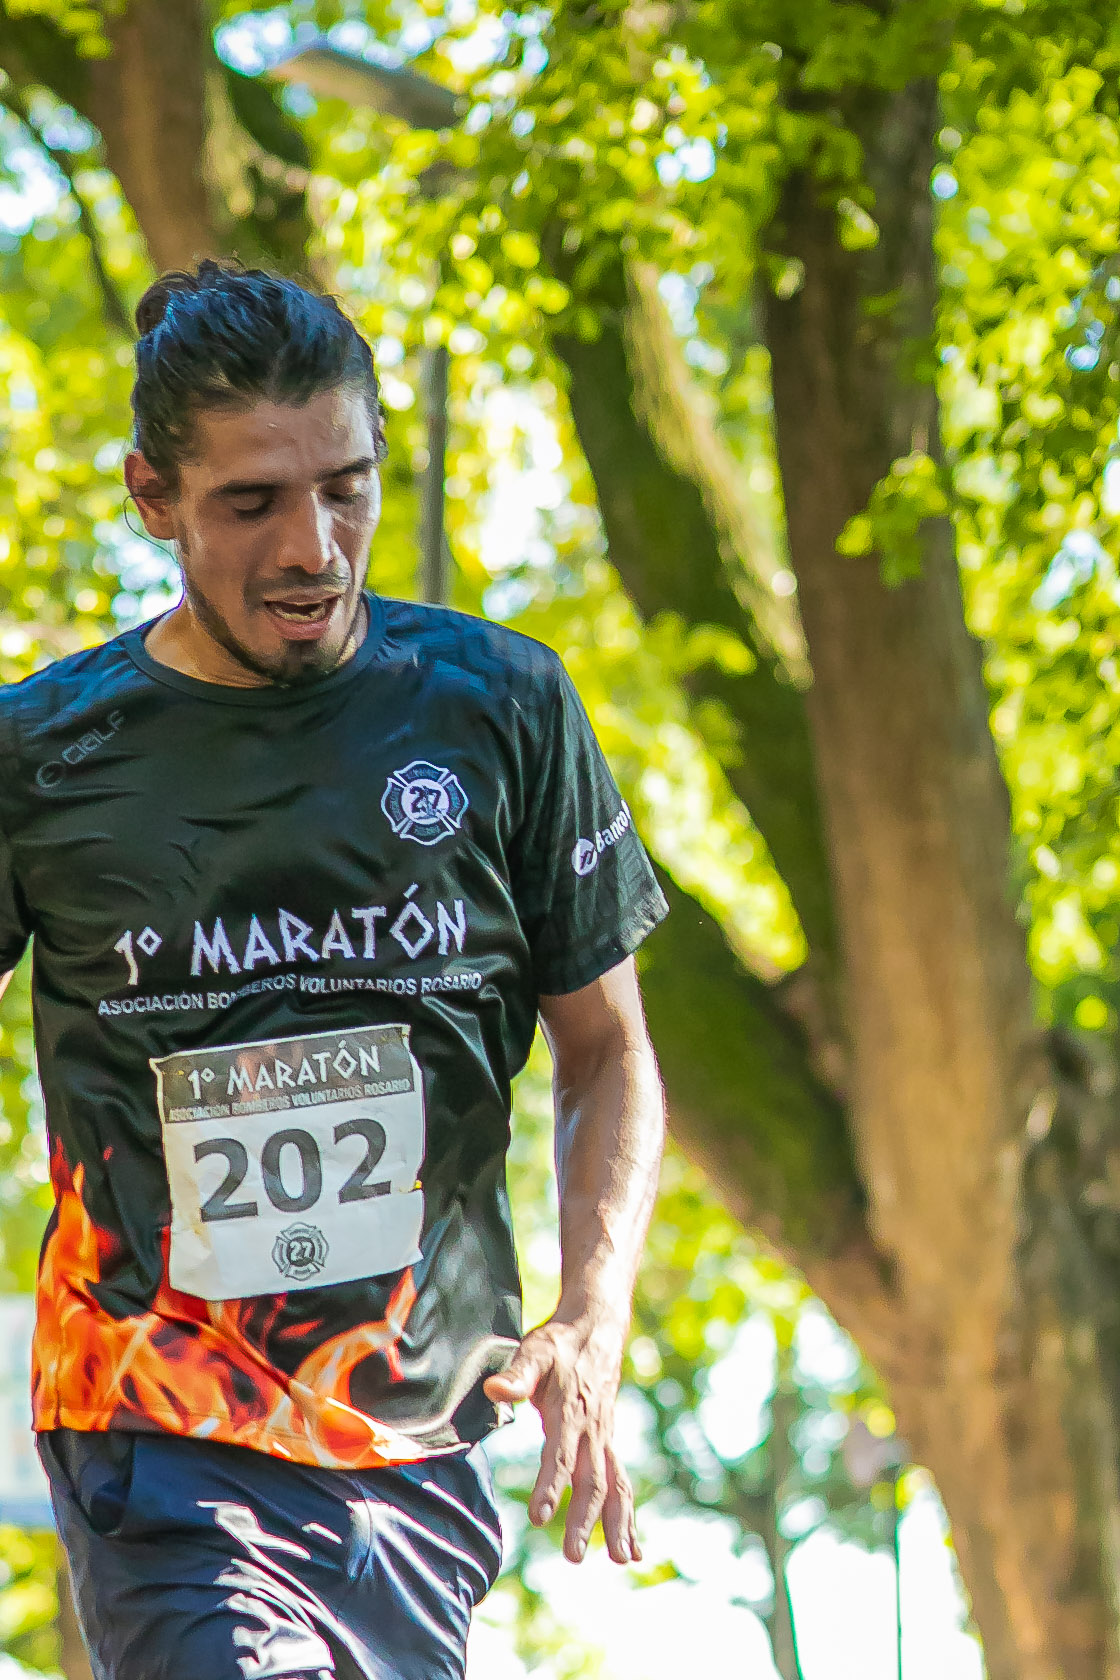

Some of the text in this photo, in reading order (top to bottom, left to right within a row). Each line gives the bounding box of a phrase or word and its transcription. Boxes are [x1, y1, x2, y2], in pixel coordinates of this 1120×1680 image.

[408, 784, 442, 814] 27
[190, 882, 468, 977] MARATÓN
[299, 974, 418, 996] VOLUNTARIOS
[421, 972, 482, 994] ROSARIO
[226, 1040, 382, 1095] MARATÓN
[193, 1118, 391, 1222] 202
[290, 1240, 313, 1262] 27
